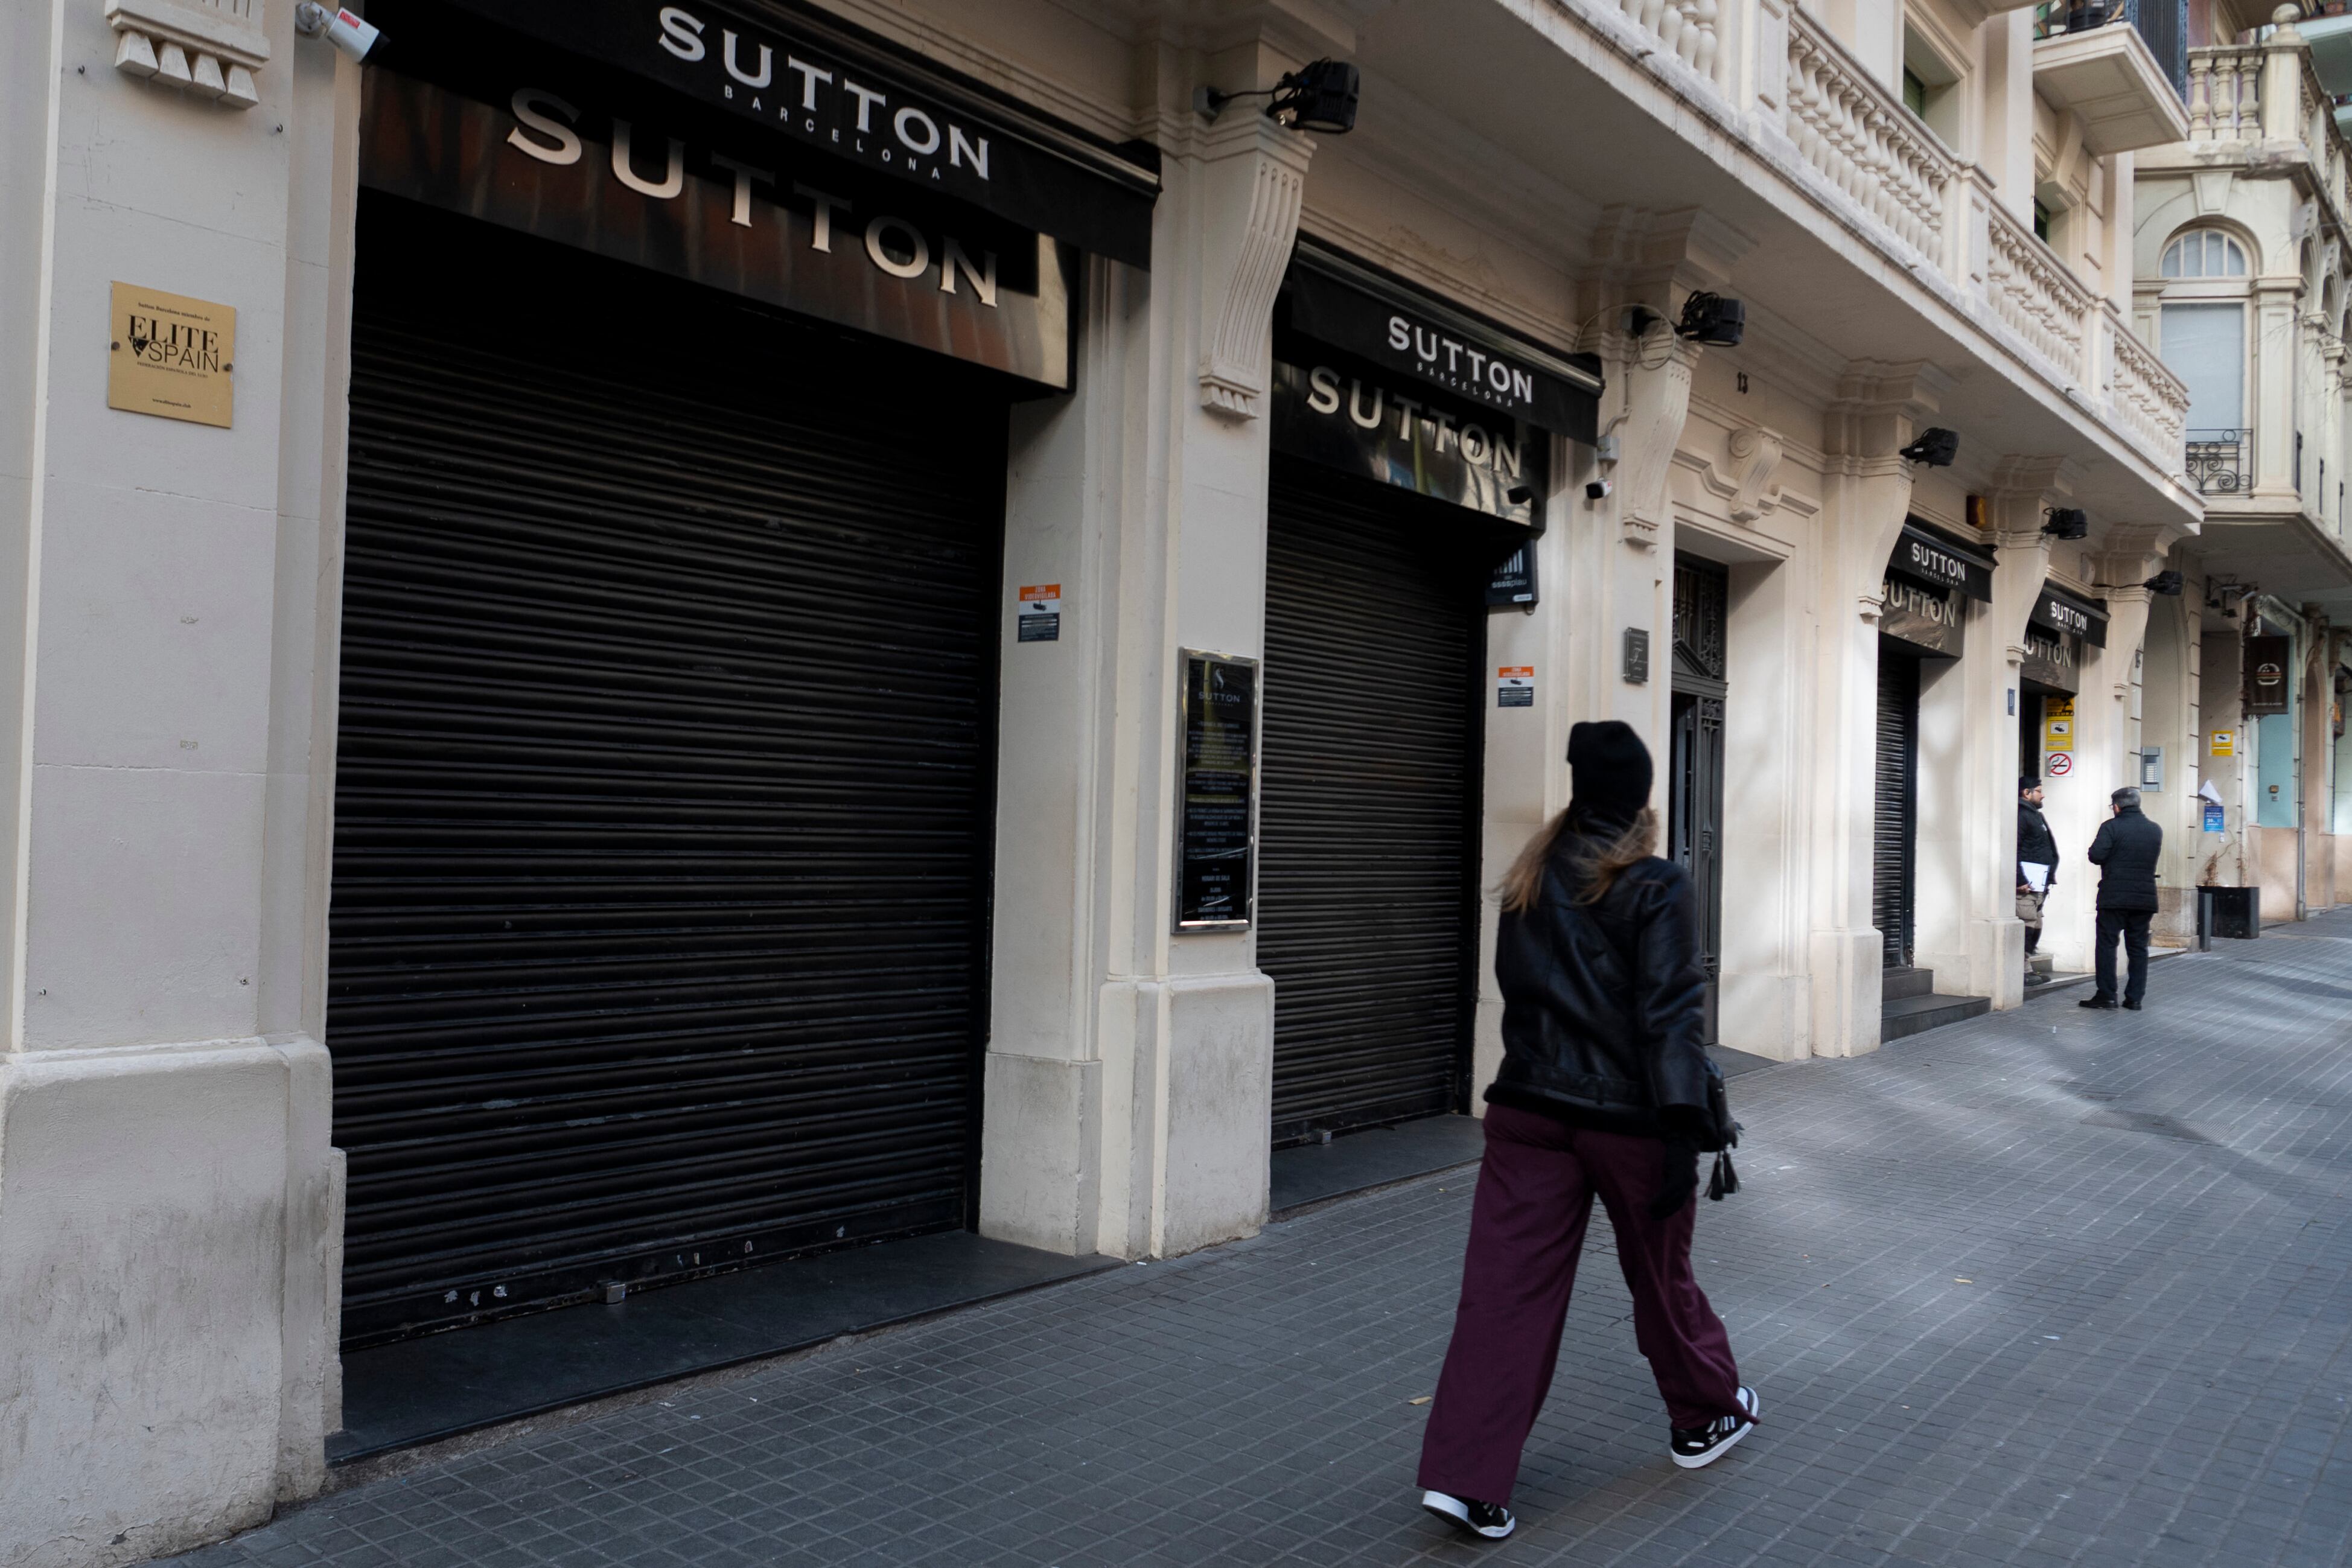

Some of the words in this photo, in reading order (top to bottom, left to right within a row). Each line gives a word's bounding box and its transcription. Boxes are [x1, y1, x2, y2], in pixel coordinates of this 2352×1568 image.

[658, 6, 989, 180] SUTTON
[724, 85, 940, 180] BARCELONA
[506, 88, 998, 308] SUTTON
[156, 306, 180, 315] Barcelona
[128, 314, 218, 353] ELITE
[148, 342, 218, 373] SPAIN
[1388, 316, 1532, 403] SUTTON
[1417, 362, 1512, 407] BARCELONA
[1737, 371, 1748, 394] 13
[1306, 365, 1522, 479] SUTTON
[1911, 543, 1965, 581] SUTTON
[2051, 601, 2087, 631] SUTTON
[2024, 632, 2071, 668] UTTON
[1198, 691, 1240, 703] SUTTON
